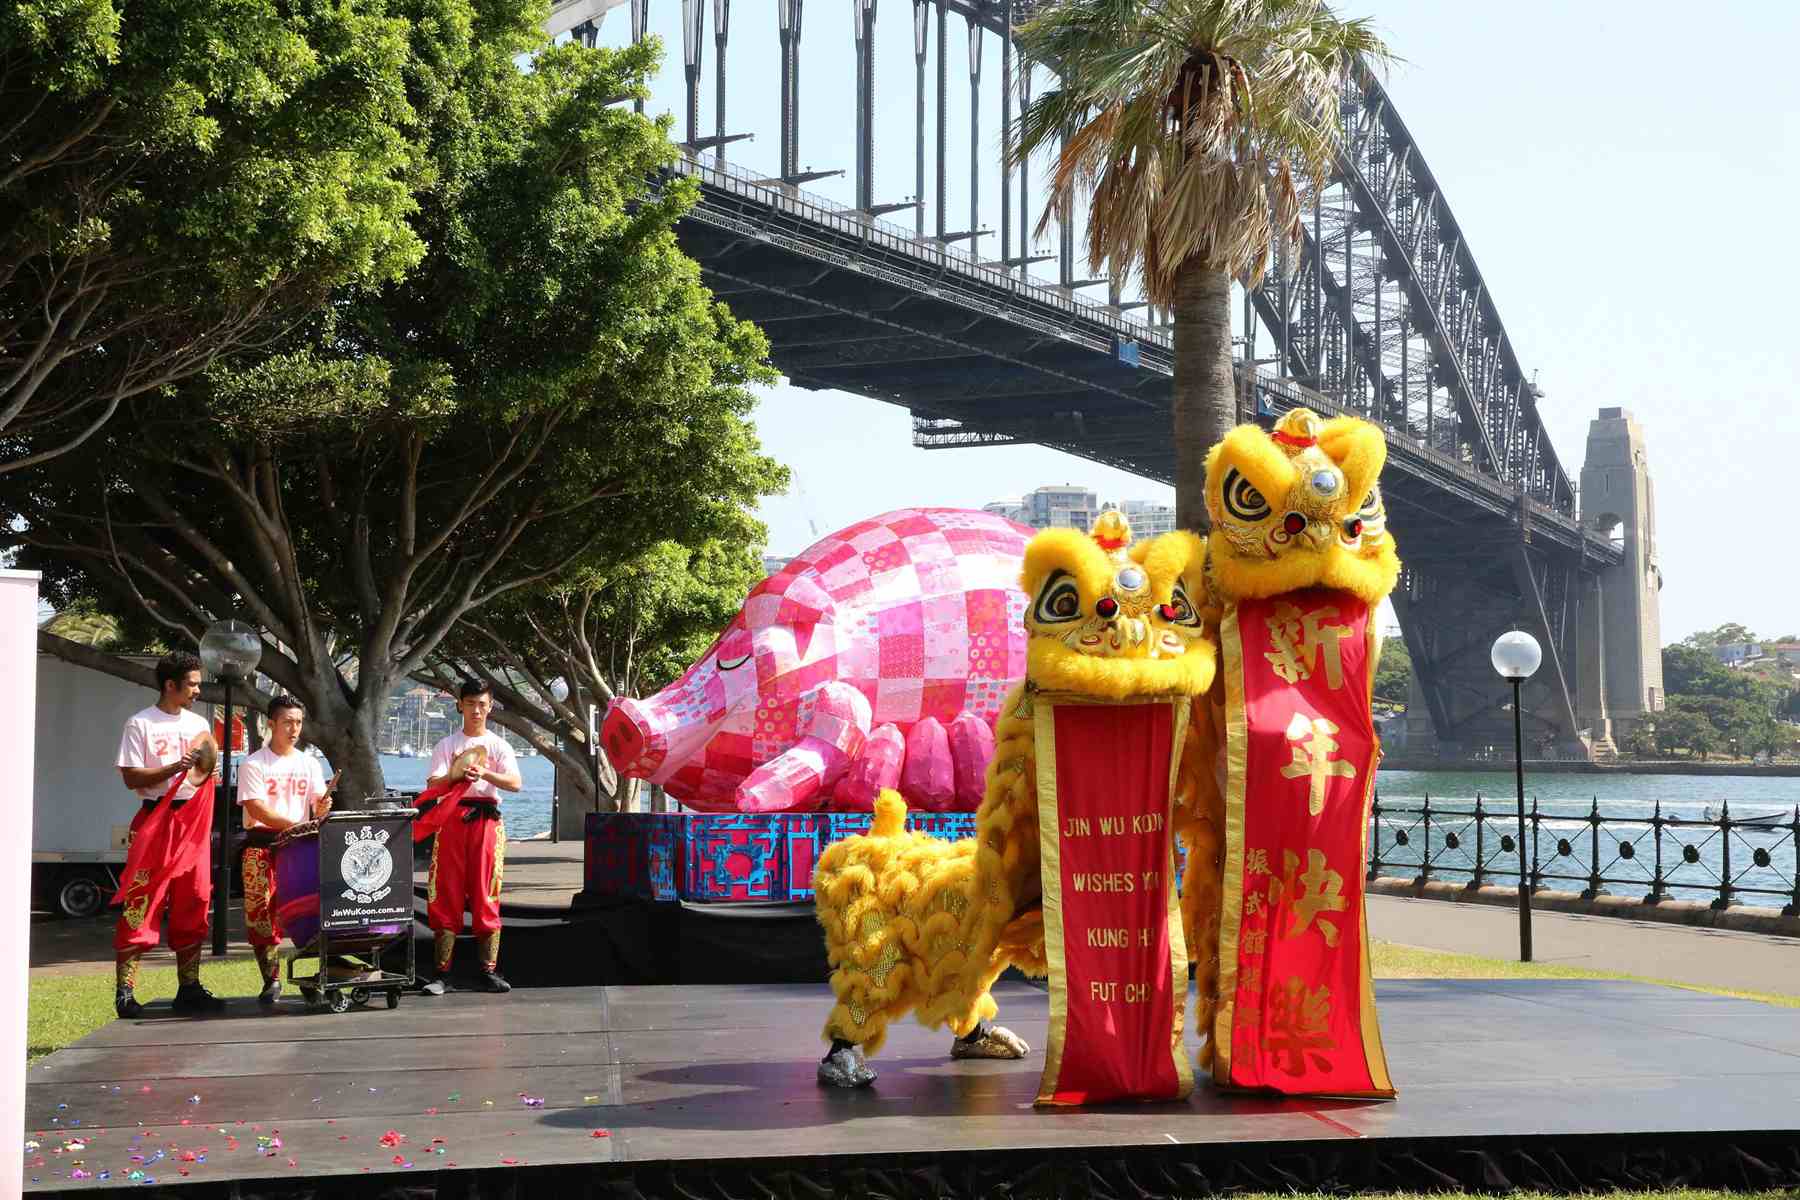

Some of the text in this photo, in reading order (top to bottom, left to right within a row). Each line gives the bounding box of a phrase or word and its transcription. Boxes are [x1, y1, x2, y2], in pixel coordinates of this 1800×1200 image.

[1063, 817, 1090, 837] JIN
[1100, 817, 1124, 836] WU
[1073, 872, 1134, 893] WISHES
[331, 907, 405, 917] JinWuKoon.com.au
[1087, 927, 1129, 948] KUNG
[1090, 981, 1118, 1002] FUT
